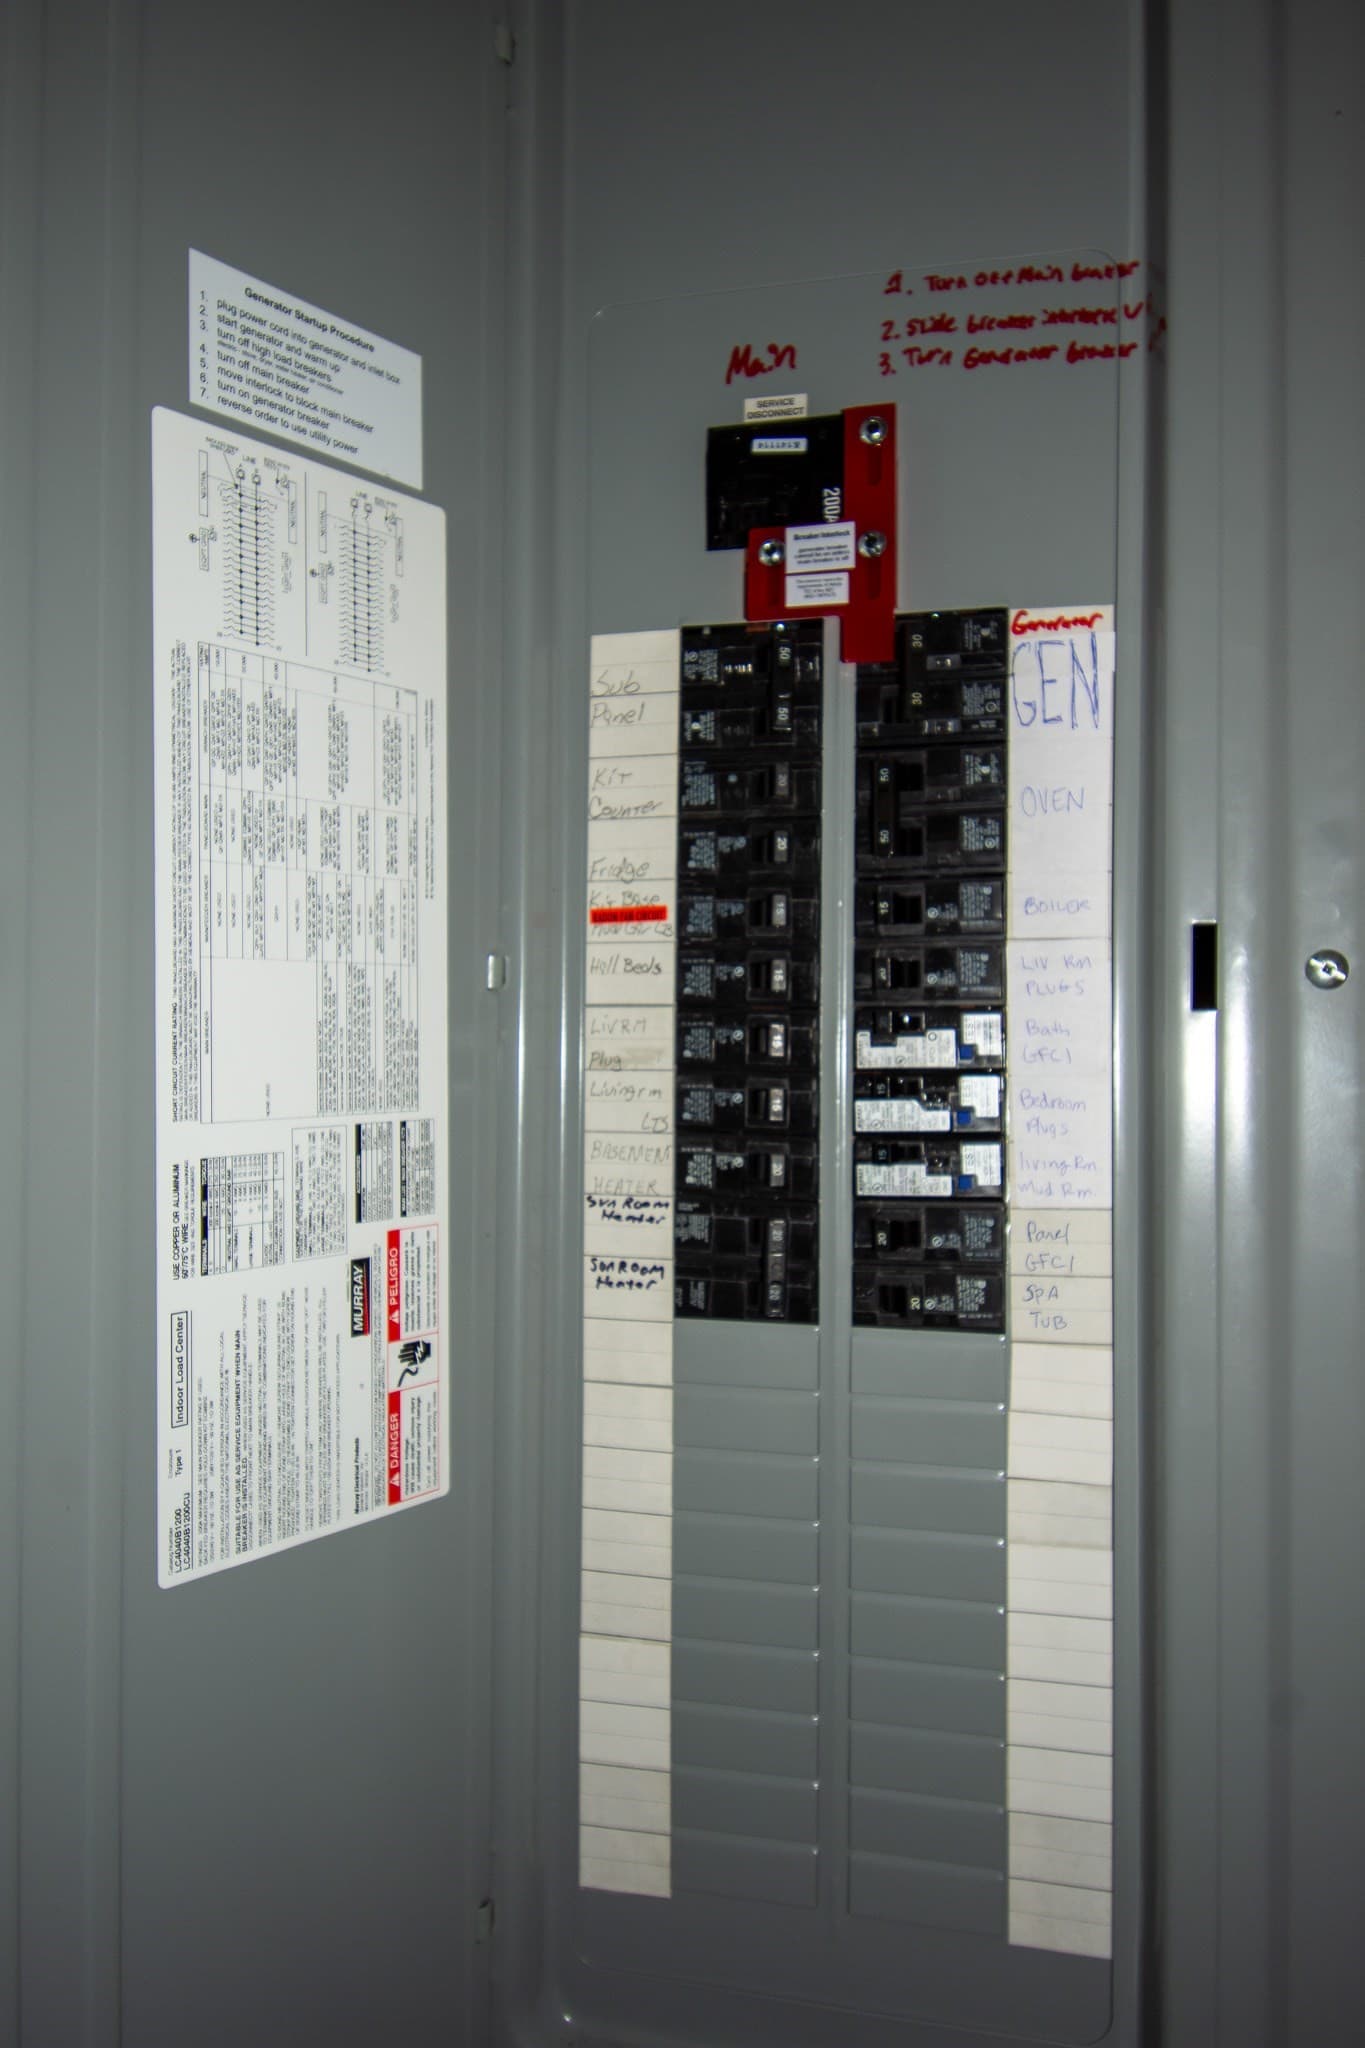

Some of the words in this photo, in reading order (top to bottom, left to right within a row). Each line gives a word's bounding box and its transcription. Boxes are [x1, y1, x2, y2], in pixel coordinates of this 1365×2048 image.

[923, 273, 969, 292] Turn
[245, 287, 292, 316] Generator
[295, 309, 328, 333] Startup
[330, 325, 374, 352] Procedure
[880, 318, 902, 342] 2.
[200, 304, 209, 317] 2.
[217, 313, 238, 328] start
[240, 324, 283, 348] generator
[286, 342, 302, 357] and
[305, 350, 328, 367] warm
[330, 362, 341, 374] up
[200, 318, 209, 331] 3.
[217, 327, 236, 343] turn
[238, 335, 250, 349] off
[251, 341, 271, 359] high
[274, 349, 292, 366] load
[217, 299, 237, 316] plug
[240, 309, 267, 327] power
[269, 320, 289, 337] cord
[309, 339, 350, 361] generator
[351, 356, 367, 370] and
[200, 343, 209, 354] 4.
[217, 350, 236, 366] turn
[238, 358, 250, 371] off
[252, 365, 274, 381] main
[276, 373, 310, 394] breaker
[724, 342, 797, 386] Main
[879, 351, 898, 376] 3.
[902, 345, 953, 368] Turn
[200, 371, 209, 384] 6.
[217, 379, 236, 395] turn
[238, 388, 250, 400] on
[252, 394, 295, 416] generator
[297, 409, 330, 430] breaker
[217, 366, 243, 383] move
[245, 376, 282, 398] interlock
[285, 391, 294, 404] to
[296, 394, 319, 412] block
[321, 407, 341, 422] main
[343, 412, 374, 433] breaker
[747, 406, 805, 420] DISCONNECT
[756, 397, 796, 409] SERVICE
[200, 386, 209, 400] 7.
[217, 395, 253, 415] reverse
[254, 408, 279, 424] order
[281, 417, 290, 430] to
[291, 423, 308, 436] use
[309, 428, 331, 447] utility
[911, 634, 923, 648] 30
[592, 669, 641, 697] Sub
[1011, 631, 1100, 730] GEN
[911, 691, 923, 705] 30
[591, 701, 646, 728] Panel
[1020, 785, 1085, 818] OVEN
[590, 856, 651, 884] Fridge
[1021, 956, 1049, 970] LIV
[1026, 1018, 1071, 1037] Bath
[1020, 1087, 1087, 1112] Bedroom
[172, 1164, 180, 1208] ALUMINUM
[172, 1211, 180, 1224] OR
[1026, 1220, 1070, 1243] Panel
[172, 1226, 180, 1261] COPPER
[181, 1223, 189, 1245] WIRE
[877, 1231, 887, 1248] 20
[172, 1263, 180, 1281] USE
[389, 1247, 399, 1306] PELIGRO
[353, 1265, 364, 1331] MURRAY
[910, 1296, 921, 1311] 20
[175, 1316, 184, 1353] Center
[175, 1356, 184, 1384] Load
[175, 1387, 184, 1424] Indoor
[390, 1413, 400, 1469] DANGER
[175, 1456, 184, 1477] Type
